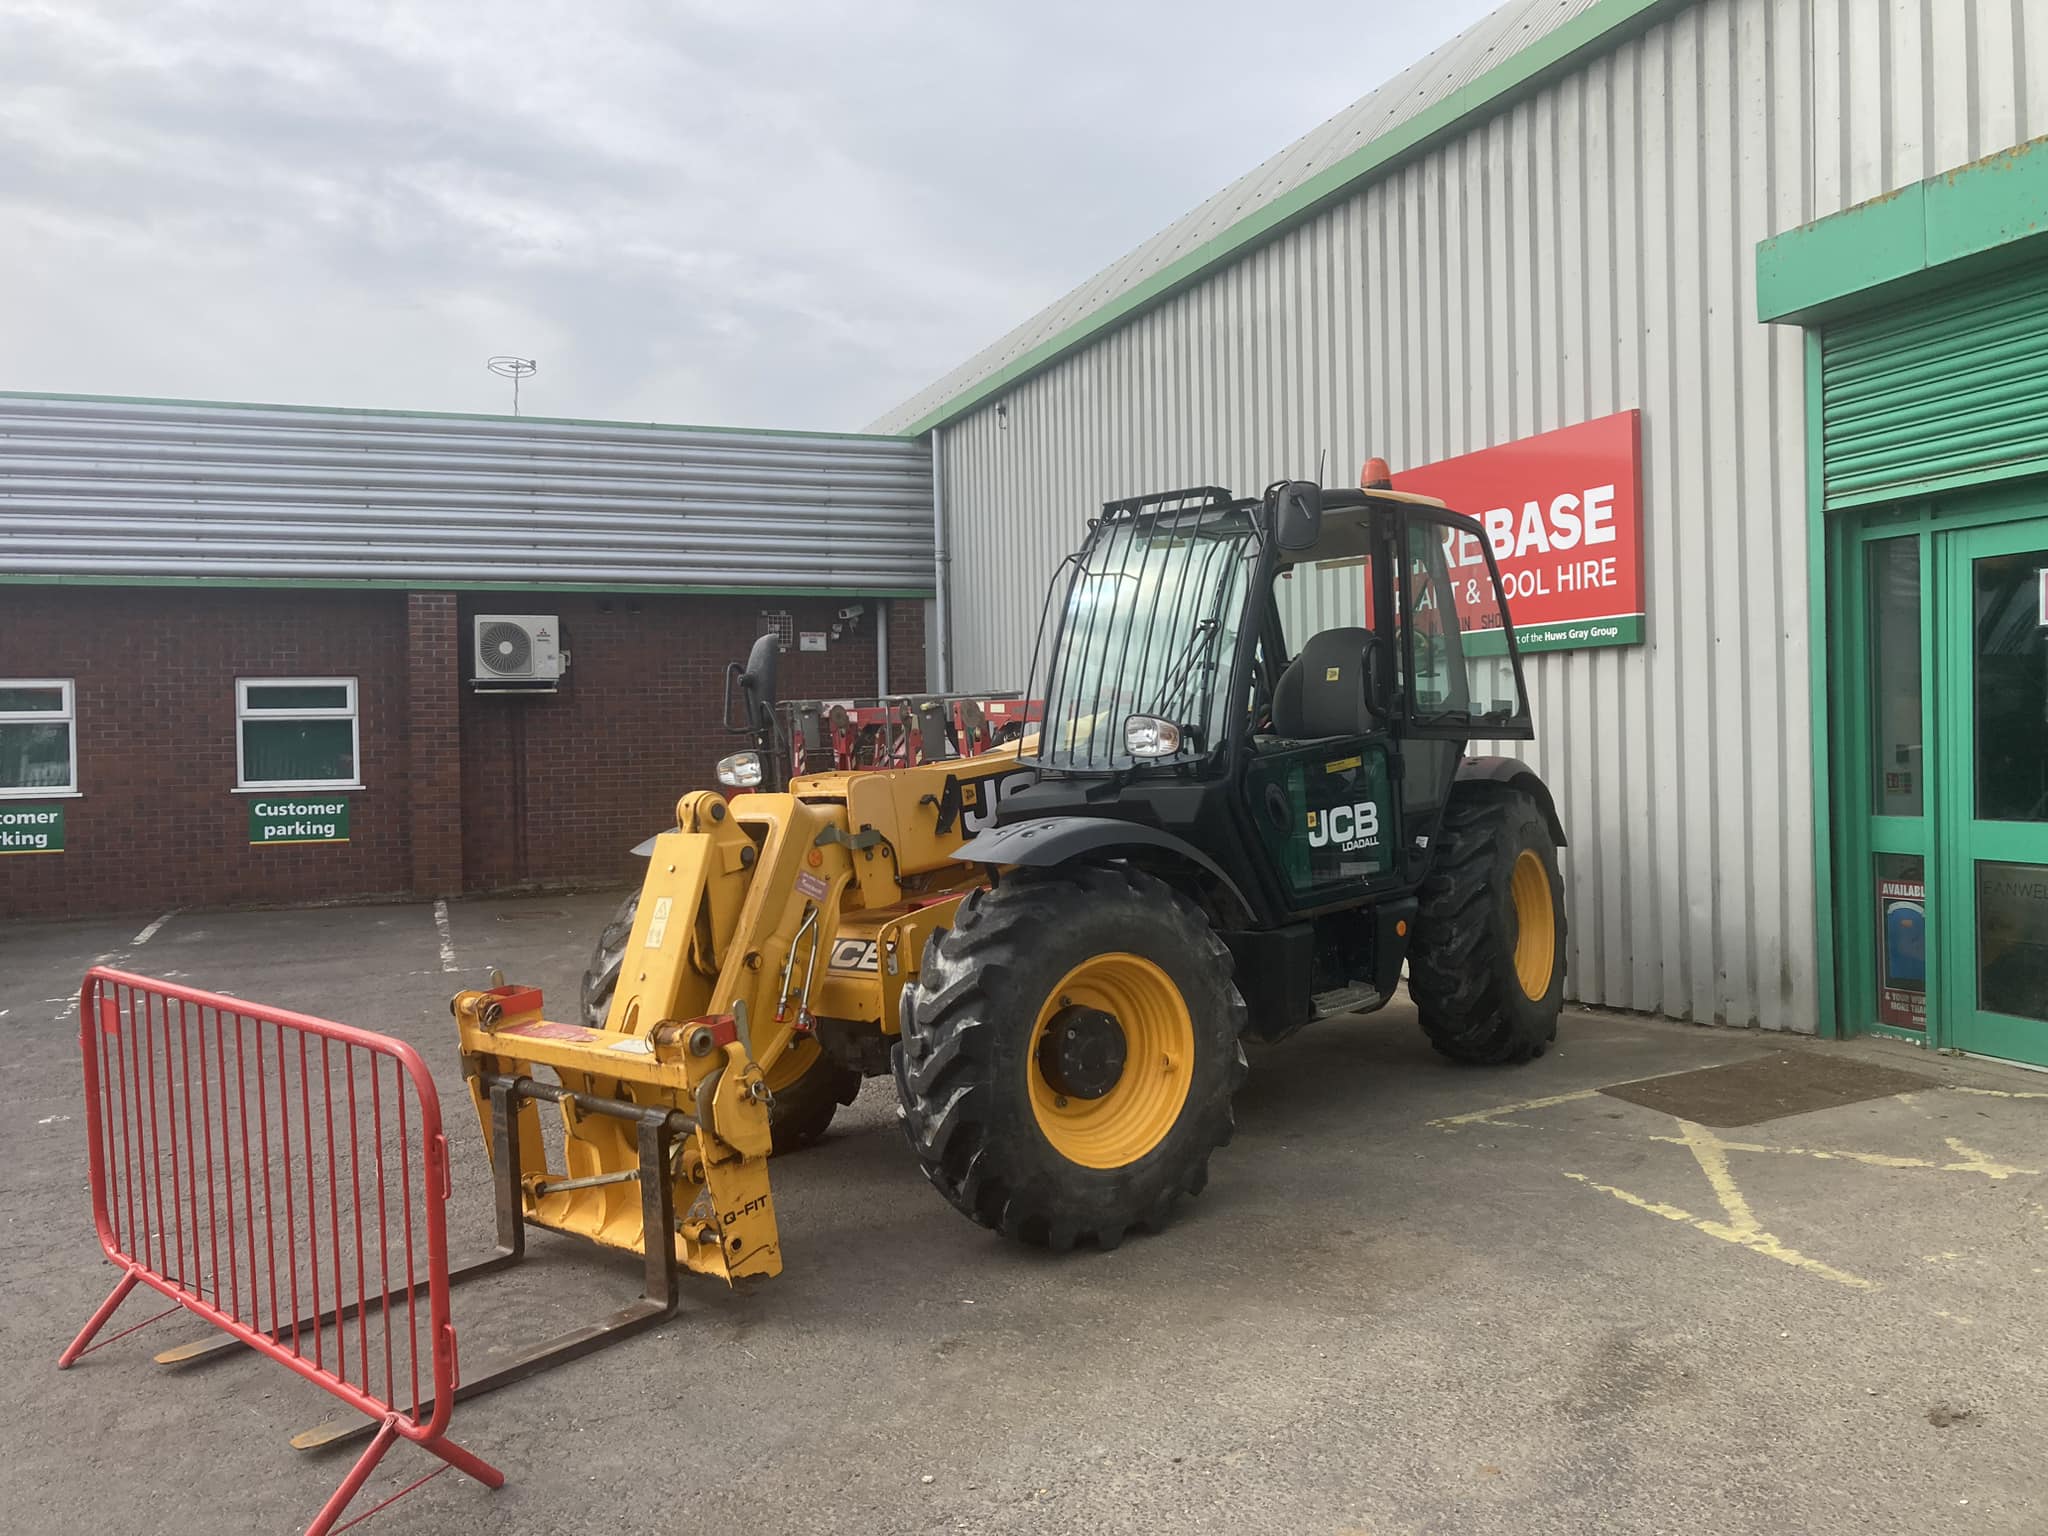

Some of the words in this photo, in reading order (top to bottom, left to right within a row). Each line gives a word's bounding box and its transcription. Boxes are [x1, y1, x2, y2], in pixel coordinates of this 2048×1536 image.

[1466, 578, 1481, 604] &
[1557, 557, 1617, 592] HIRE
[1521, 633, 1530, 643] of
[1531, 632, 1543, 642] the
[1544, 631, 1567, 641] Huws
[1568, 629, 1589, 640] Gray
[1590, 626, 1618, 637] Group
[254, 803, 344, 816] Customer
[264, 821, 335, 839] parking
[1308, 801, 1379, 848] JCB
[1342, 836, 1380, 852] LOADALL
[1882, 883, 1926, 897] AVAILABL
[723, 1195, 768, 1226] Q-FIT
